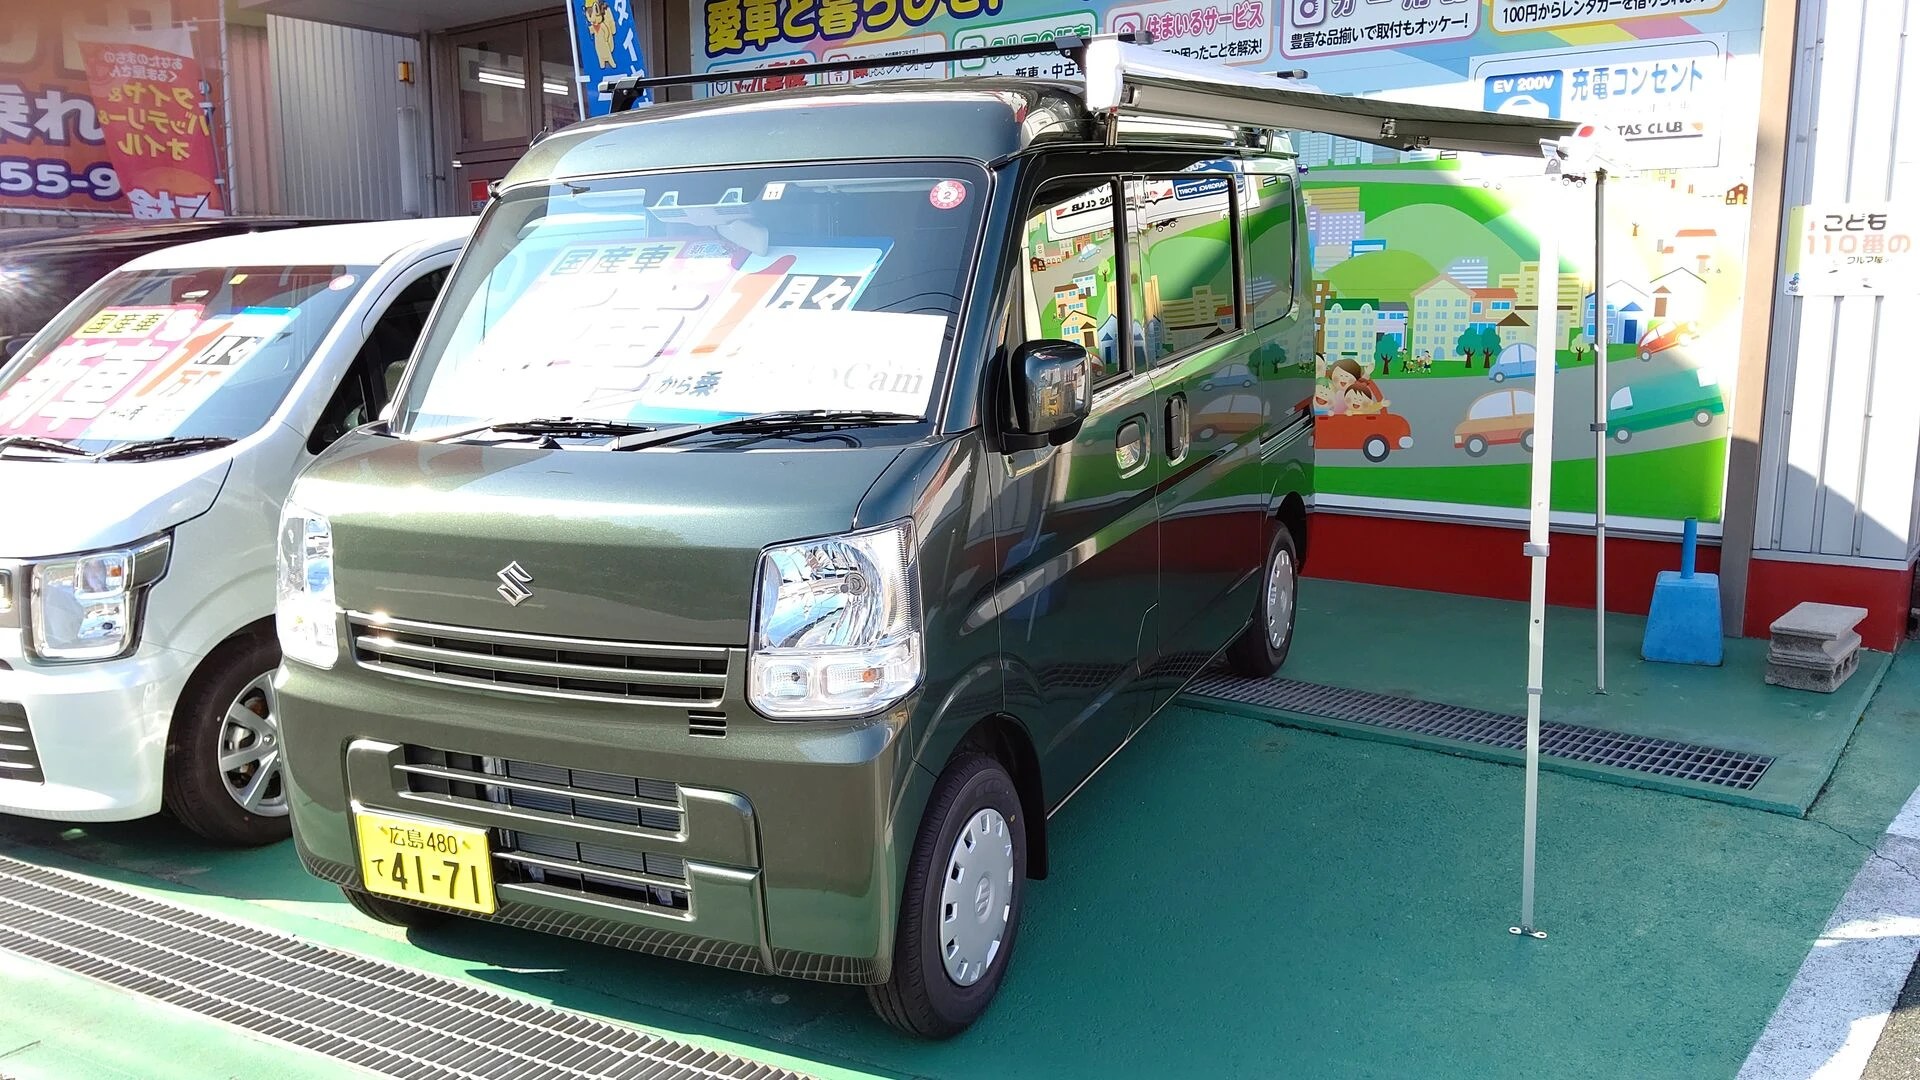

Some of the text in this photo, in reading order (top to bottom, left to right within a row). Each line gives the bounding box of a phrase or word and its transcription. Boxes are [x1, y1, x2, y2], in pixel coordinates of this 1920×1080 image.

[1146, 1, 1264, 42] 住まいるサービス
[1290, 13, 1468, 50] 豊富な品揃いで取付もオッケー!
[1015, 62, 1082, 79] 新車・中古
[1493, 75, 1556, 93] EV 200V
[1571, 60, 1703, 101] 充電コンセント
[1617, 121, 1682, 136] TAS CLUB
[943, 191, 952, 200] 2
[1823, 213, 1888, 232] こども
[550, 244, 677, 276] 国産車
[772, 275, 856, 310] 月々
[371, 852, 480, 904] て 41-71
